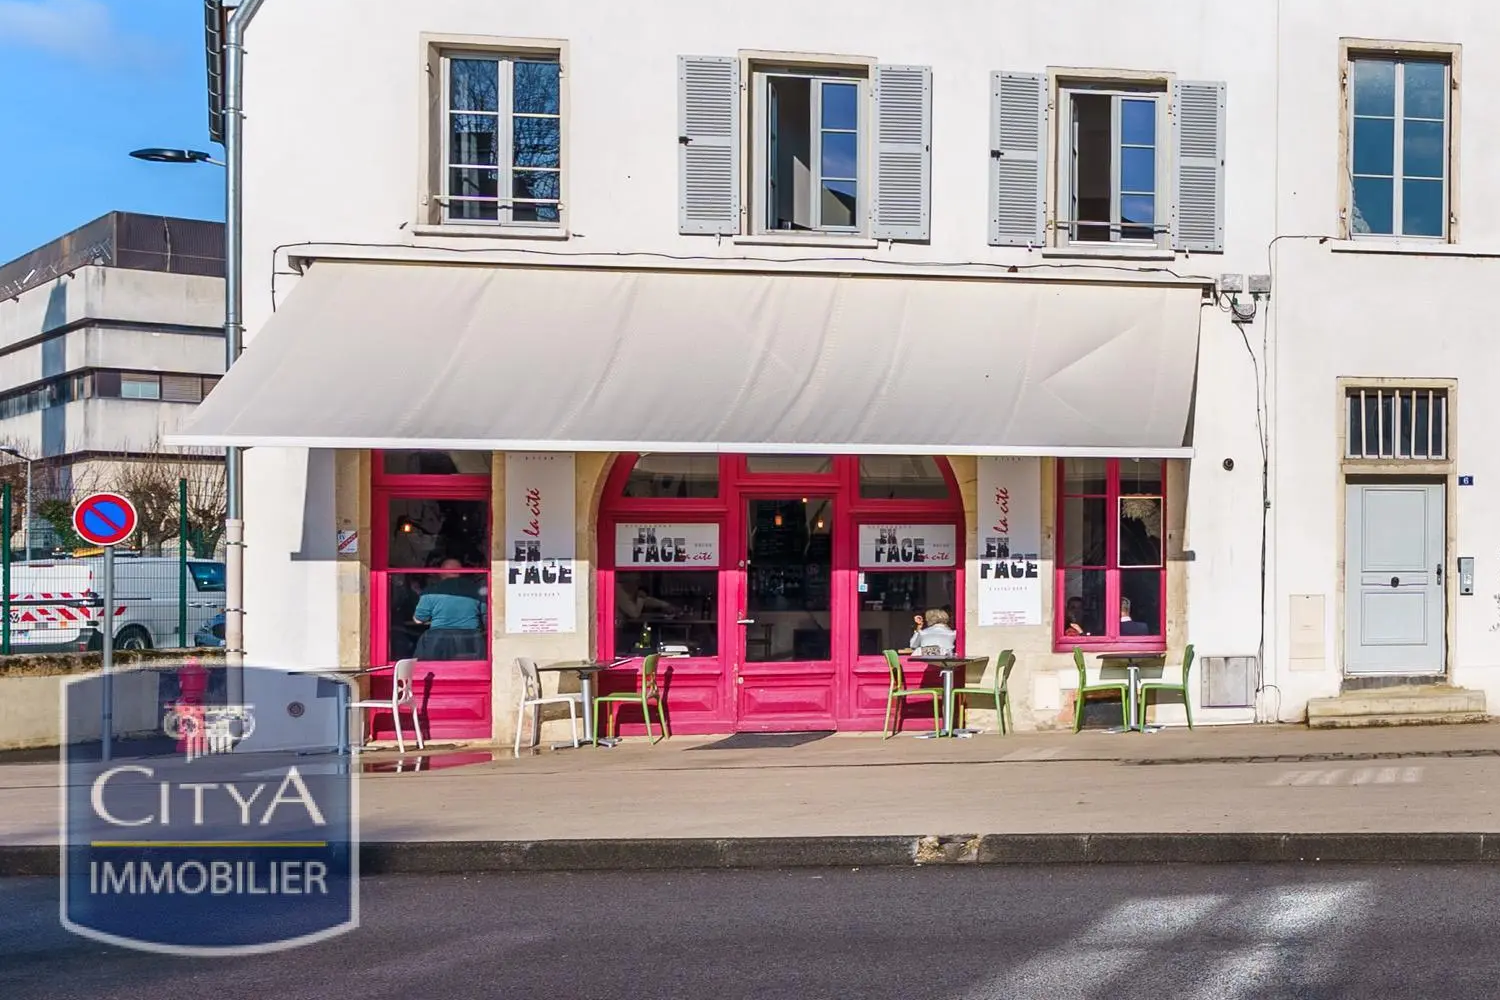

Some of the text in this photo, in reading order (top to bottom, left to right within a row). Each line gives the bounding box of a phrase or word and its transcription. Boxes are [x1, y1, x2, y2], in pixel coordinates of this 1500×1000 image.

[522, 487, 541, 537] la cité
[993, 487, 1009, 534] la cité
[638, 528, 657, 544] EN
[880, 528, 897, 544] EN
[985, 537, 1009, 559] EN
[515, 540, 540, 562] EN
[632, 538, 685, 562] FACE
[875, 538, 924, 562] FACE
[508, 557, 572, 585] FACE
[980, 554, 1038, 579] FACE
